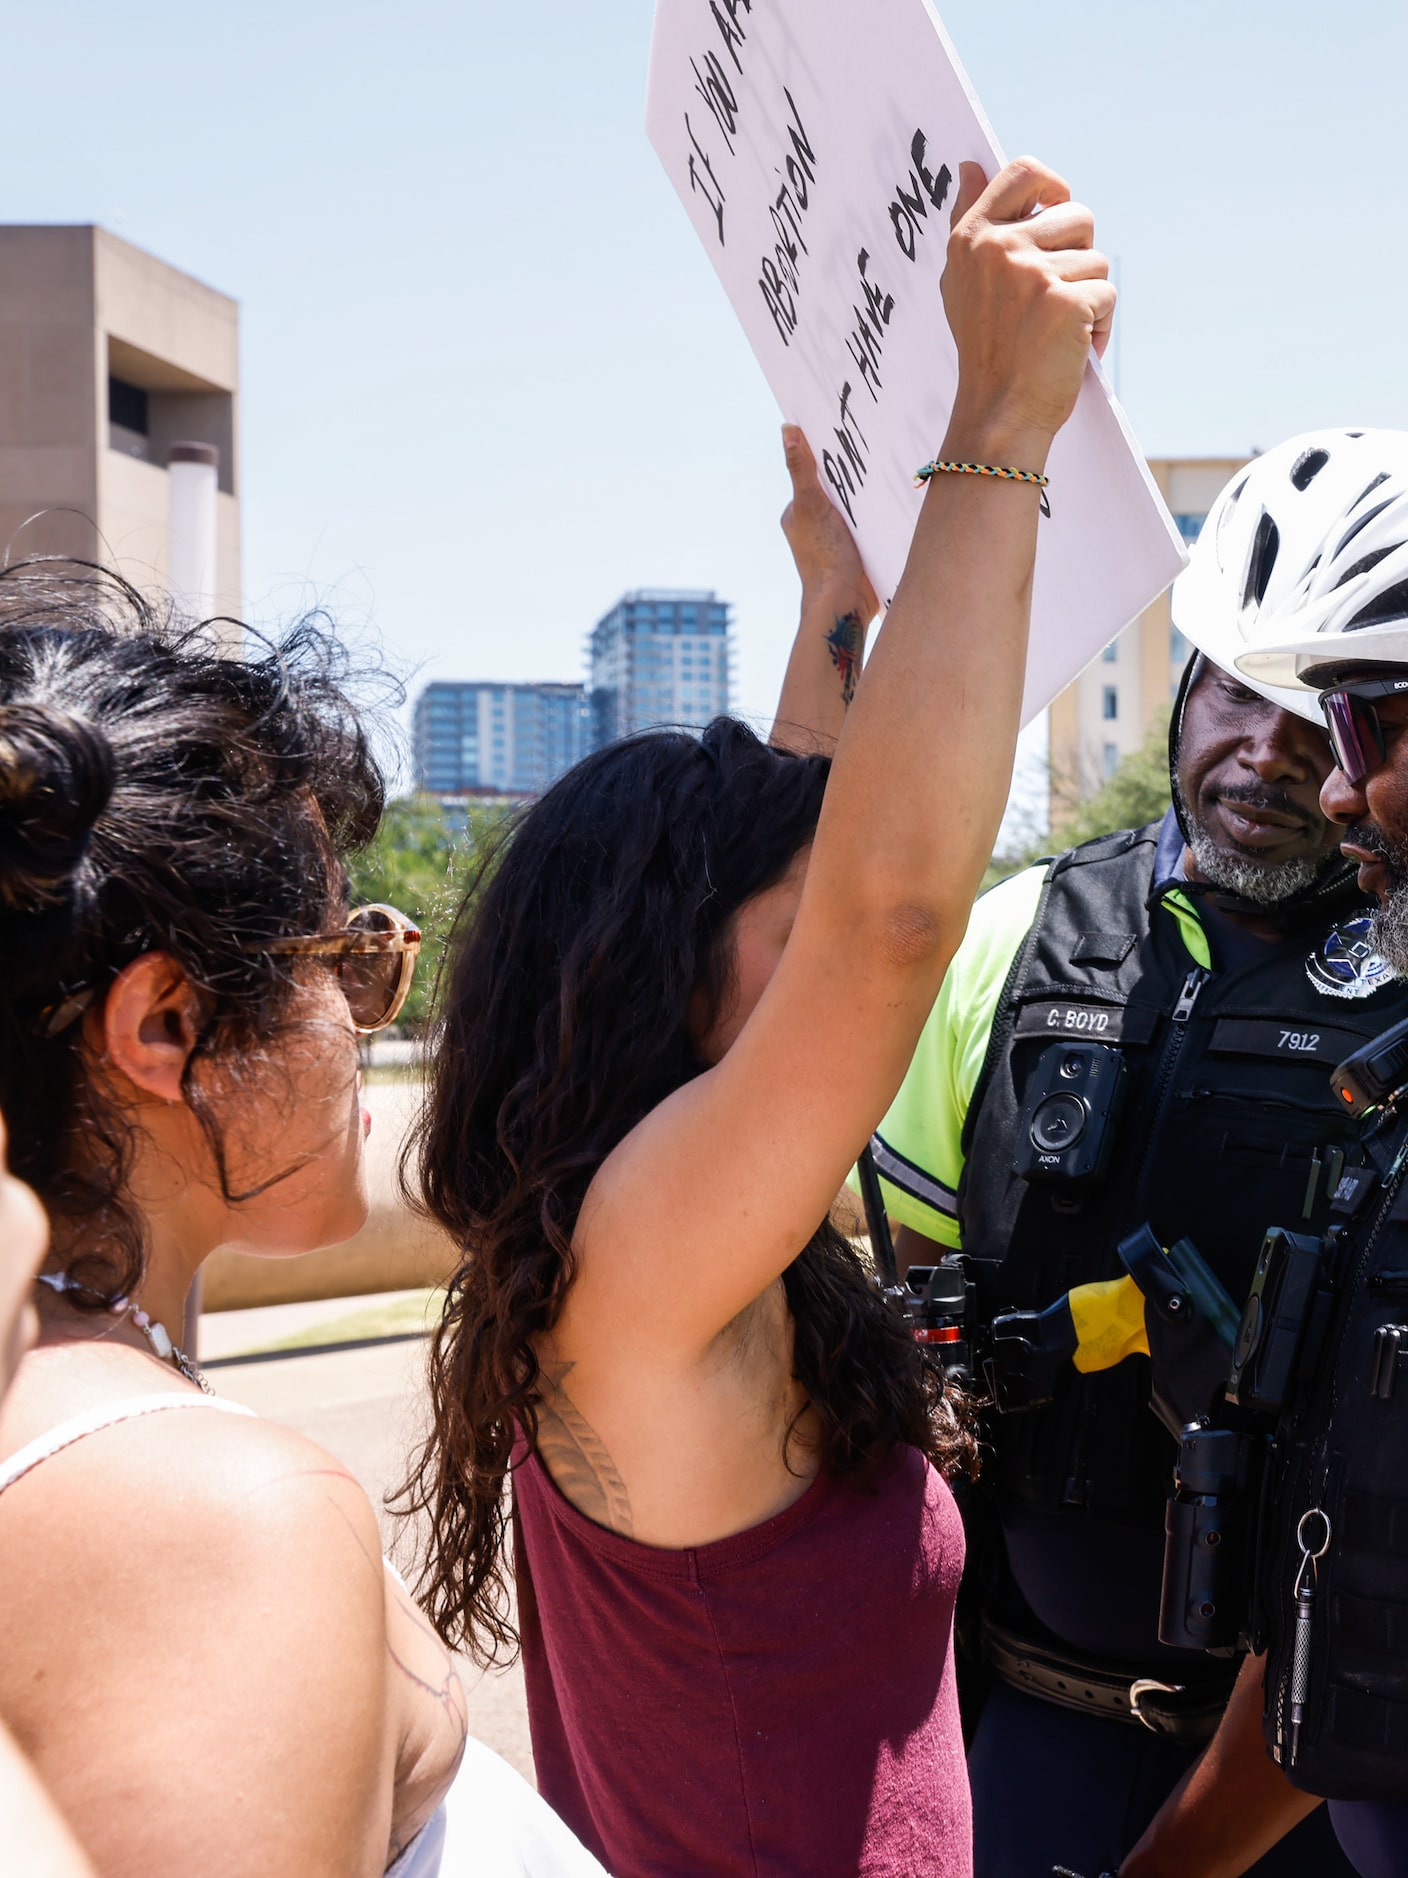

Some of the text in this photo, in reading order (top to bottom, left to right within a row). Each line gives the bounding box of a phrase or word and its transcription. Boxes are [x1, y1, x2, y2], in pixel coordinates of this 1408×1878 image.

[688, 50, 739, 156] YOU
[682, 112, 726, 248] IF
[758, 85, 816, 346] ABORTION
[844, 246, 896, 403] HAVE
[887, 127, 953, 262] ONE
[1046, 1008, 1110, 1032] C. BOYD
[1277, 1030, 1320, 1051] 7912
[1038, 1154, 1061, 1164] AXON
